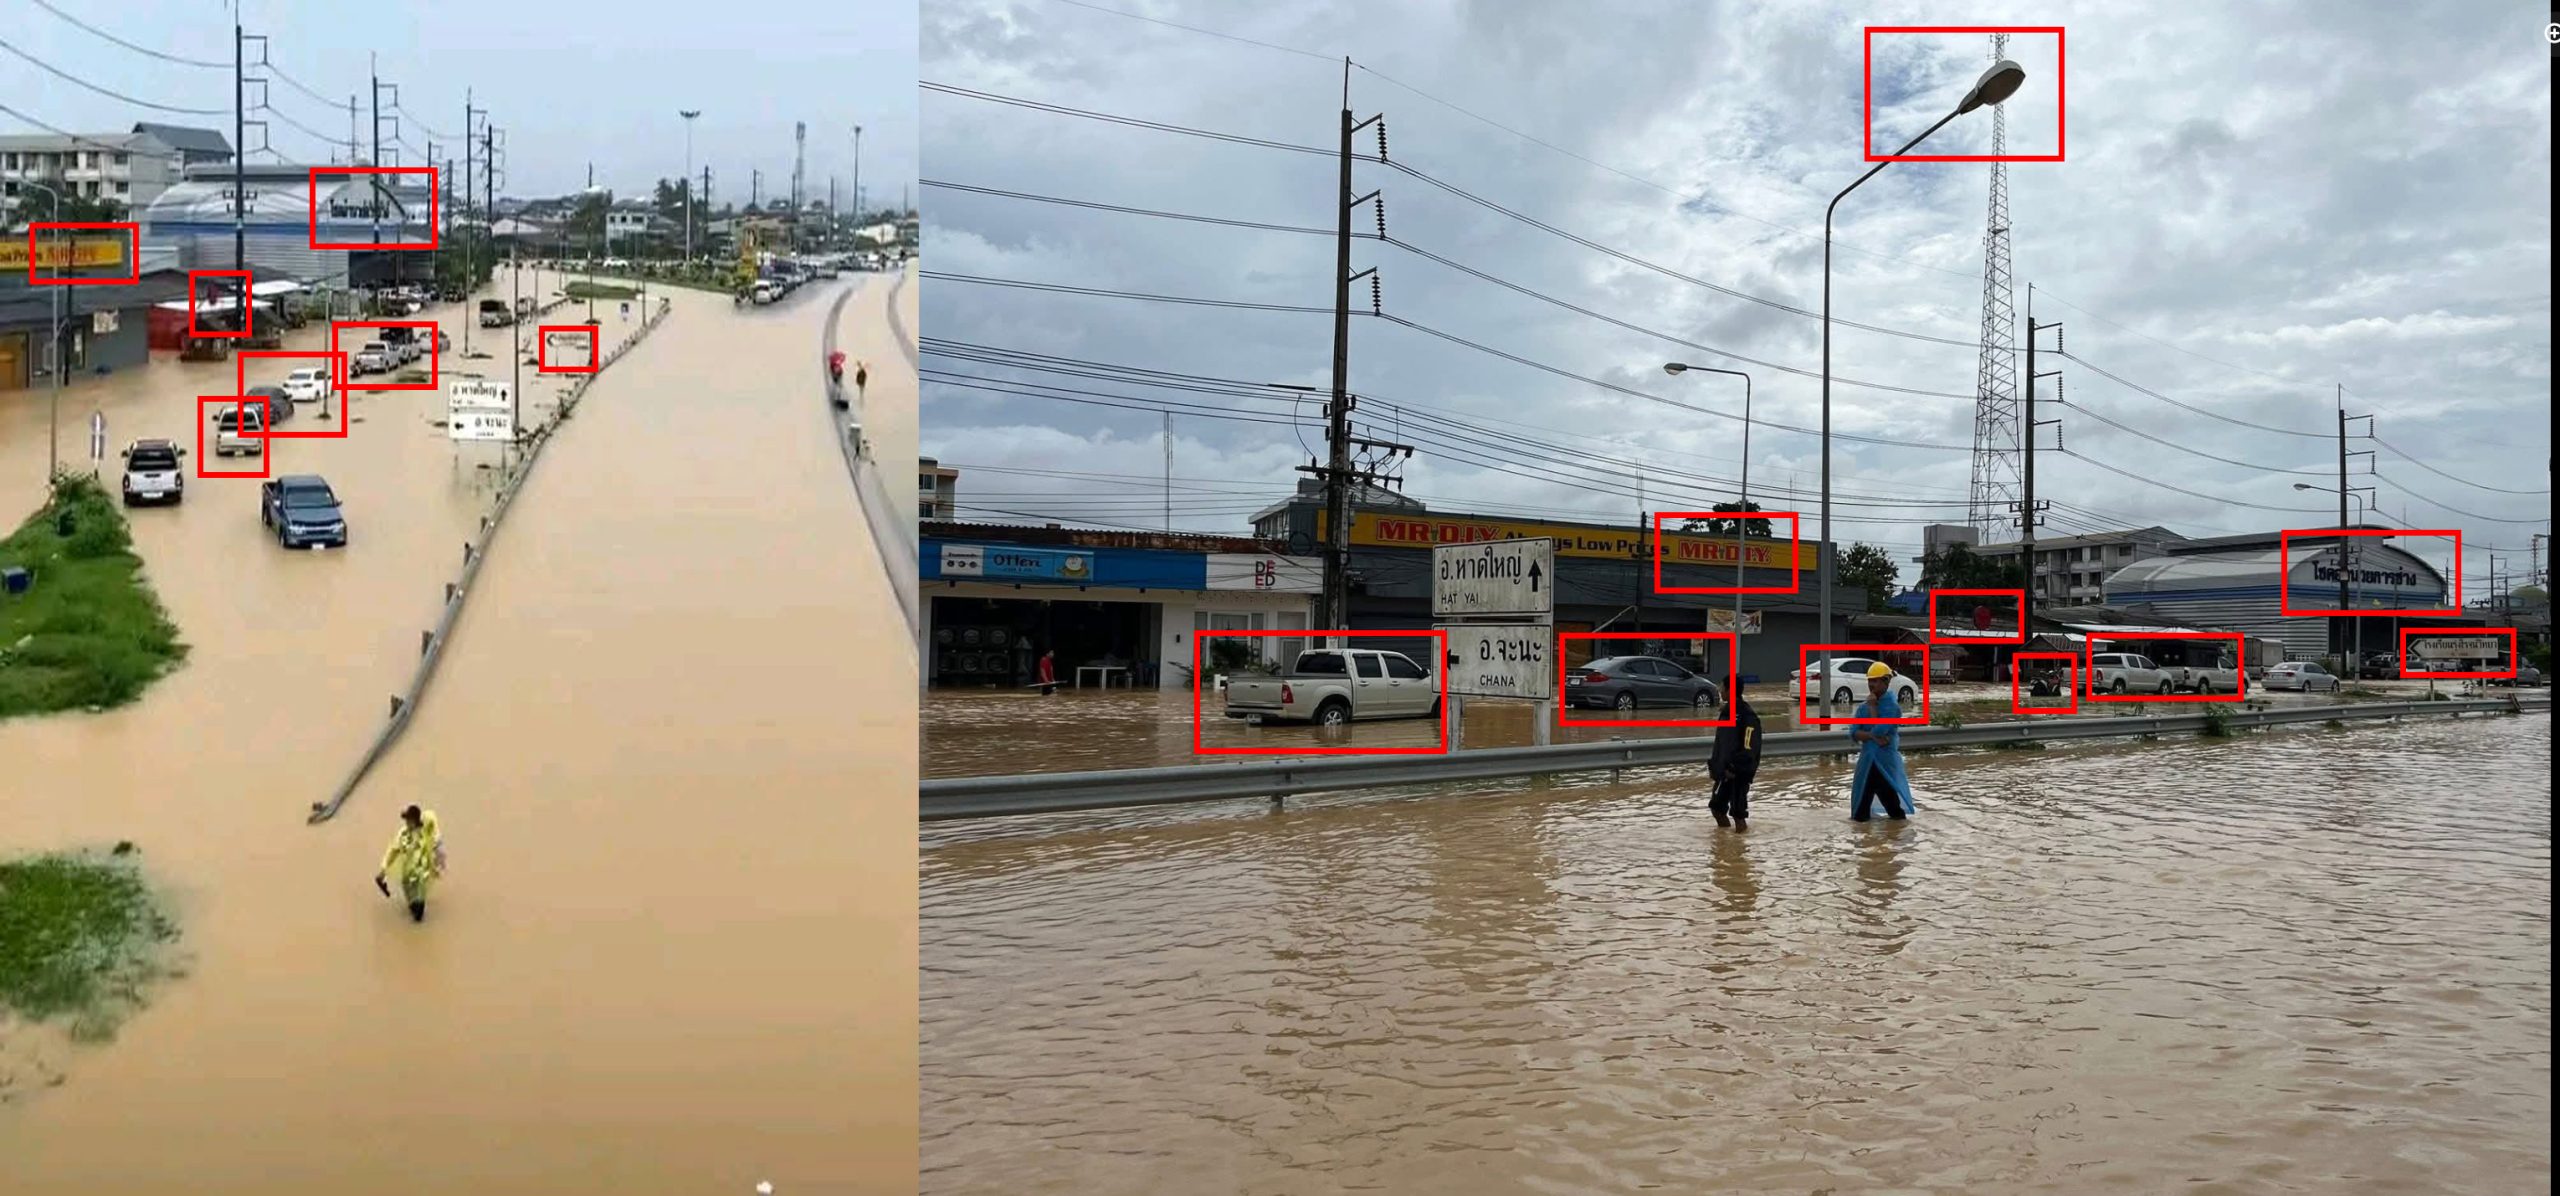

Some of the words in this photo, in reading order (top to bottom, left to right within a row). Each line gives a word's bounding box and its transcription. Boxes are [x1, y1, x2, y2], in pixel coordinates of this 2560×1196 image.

[1376, 519, 1432, 543] MR
[1577, 536, 1613, 552] Low
[1679, 540, 1720, 562] MR
[1441, 546, 1521, 585] อ.หาดใหญ่
[1442, 593, 1457, 604] HAT
[1464, 592, 1479, 604] YAI
[1480, 639, 1542, 662] อ.จะนะ
[1480, 674, 1516, 687] CHANA
